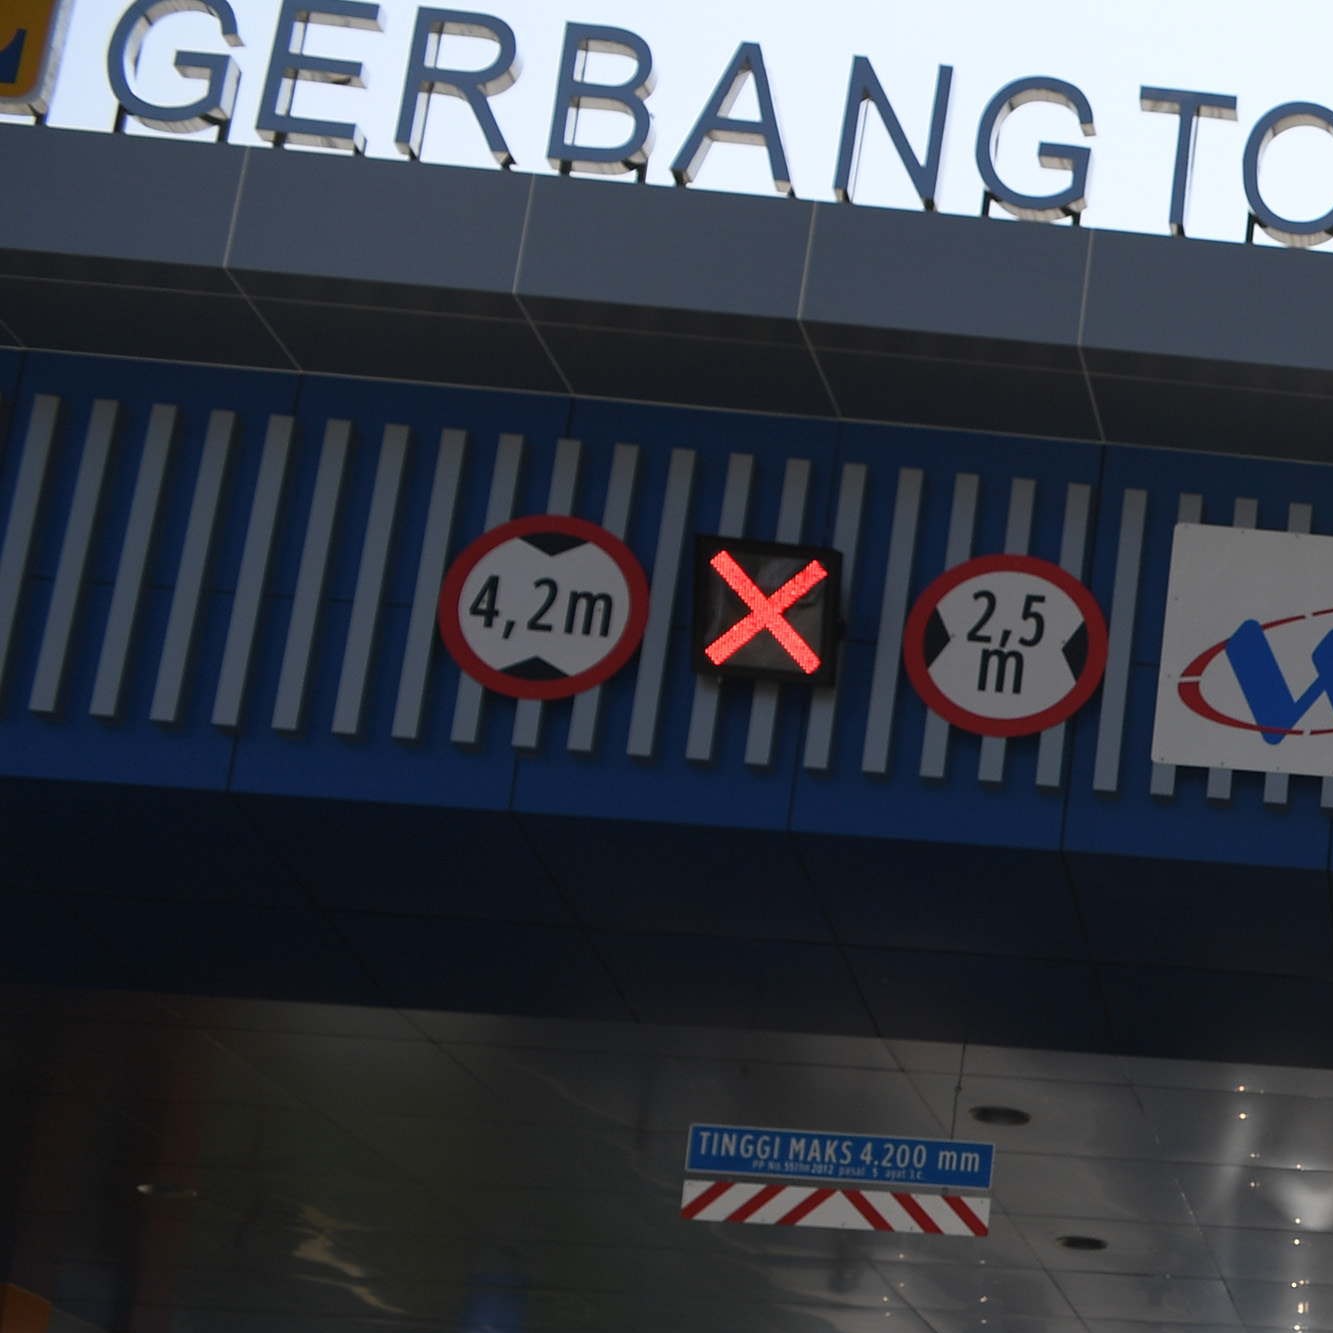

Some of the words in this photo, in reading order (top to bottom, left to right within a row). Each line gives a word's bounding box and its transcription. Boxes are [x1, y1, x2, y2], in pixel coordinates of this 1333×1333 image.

[969, 590, 1047, 648] 2,5
[977, 647, 1025, 696] m
[700, 1131, 780, 1159] TINGGI
[789, 1137, 853, 1164] MAKS
[860, 1142, 926, 1168] 4.200
[938, 1150, 980, 1173] mm
